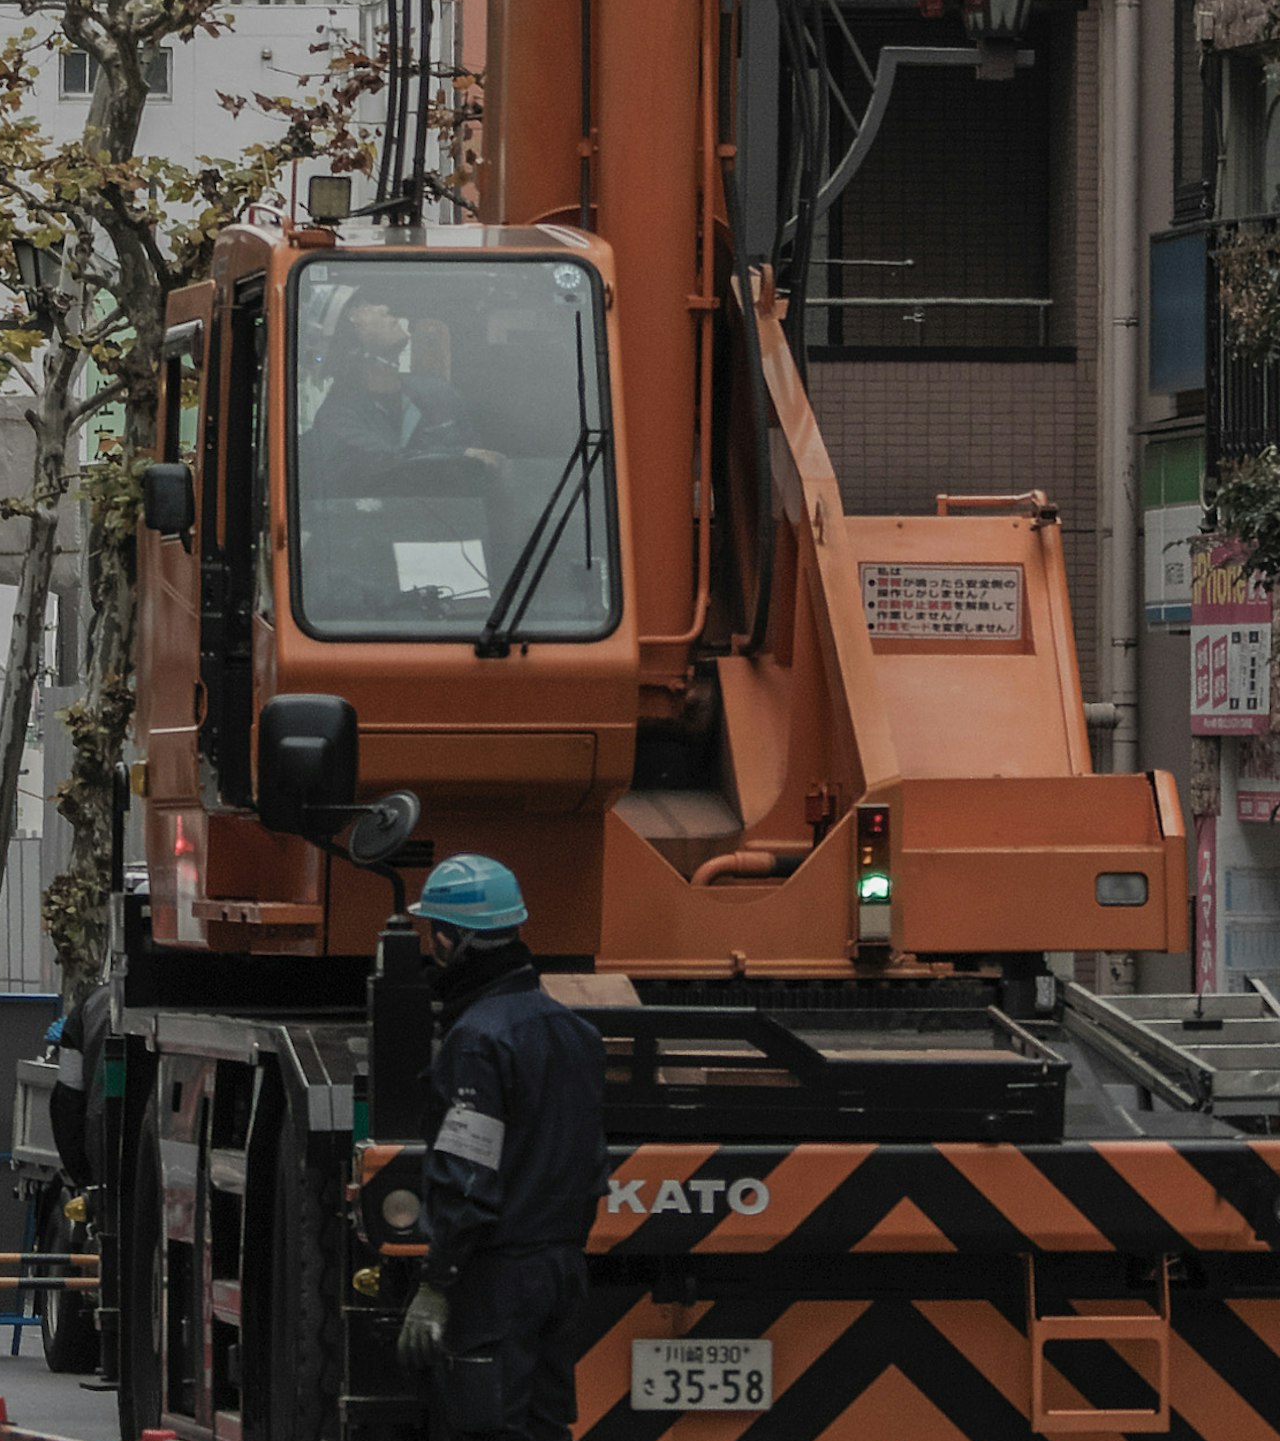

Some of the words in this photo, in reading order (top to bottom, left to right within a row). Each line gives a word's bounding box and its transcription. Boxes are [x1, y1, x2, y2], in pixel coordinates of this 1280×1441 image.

[607, 1177, 770, 1216] KATO
[706, 1346, 741, 1363] 930
[663, 1369, 764, 1405] 35-58
